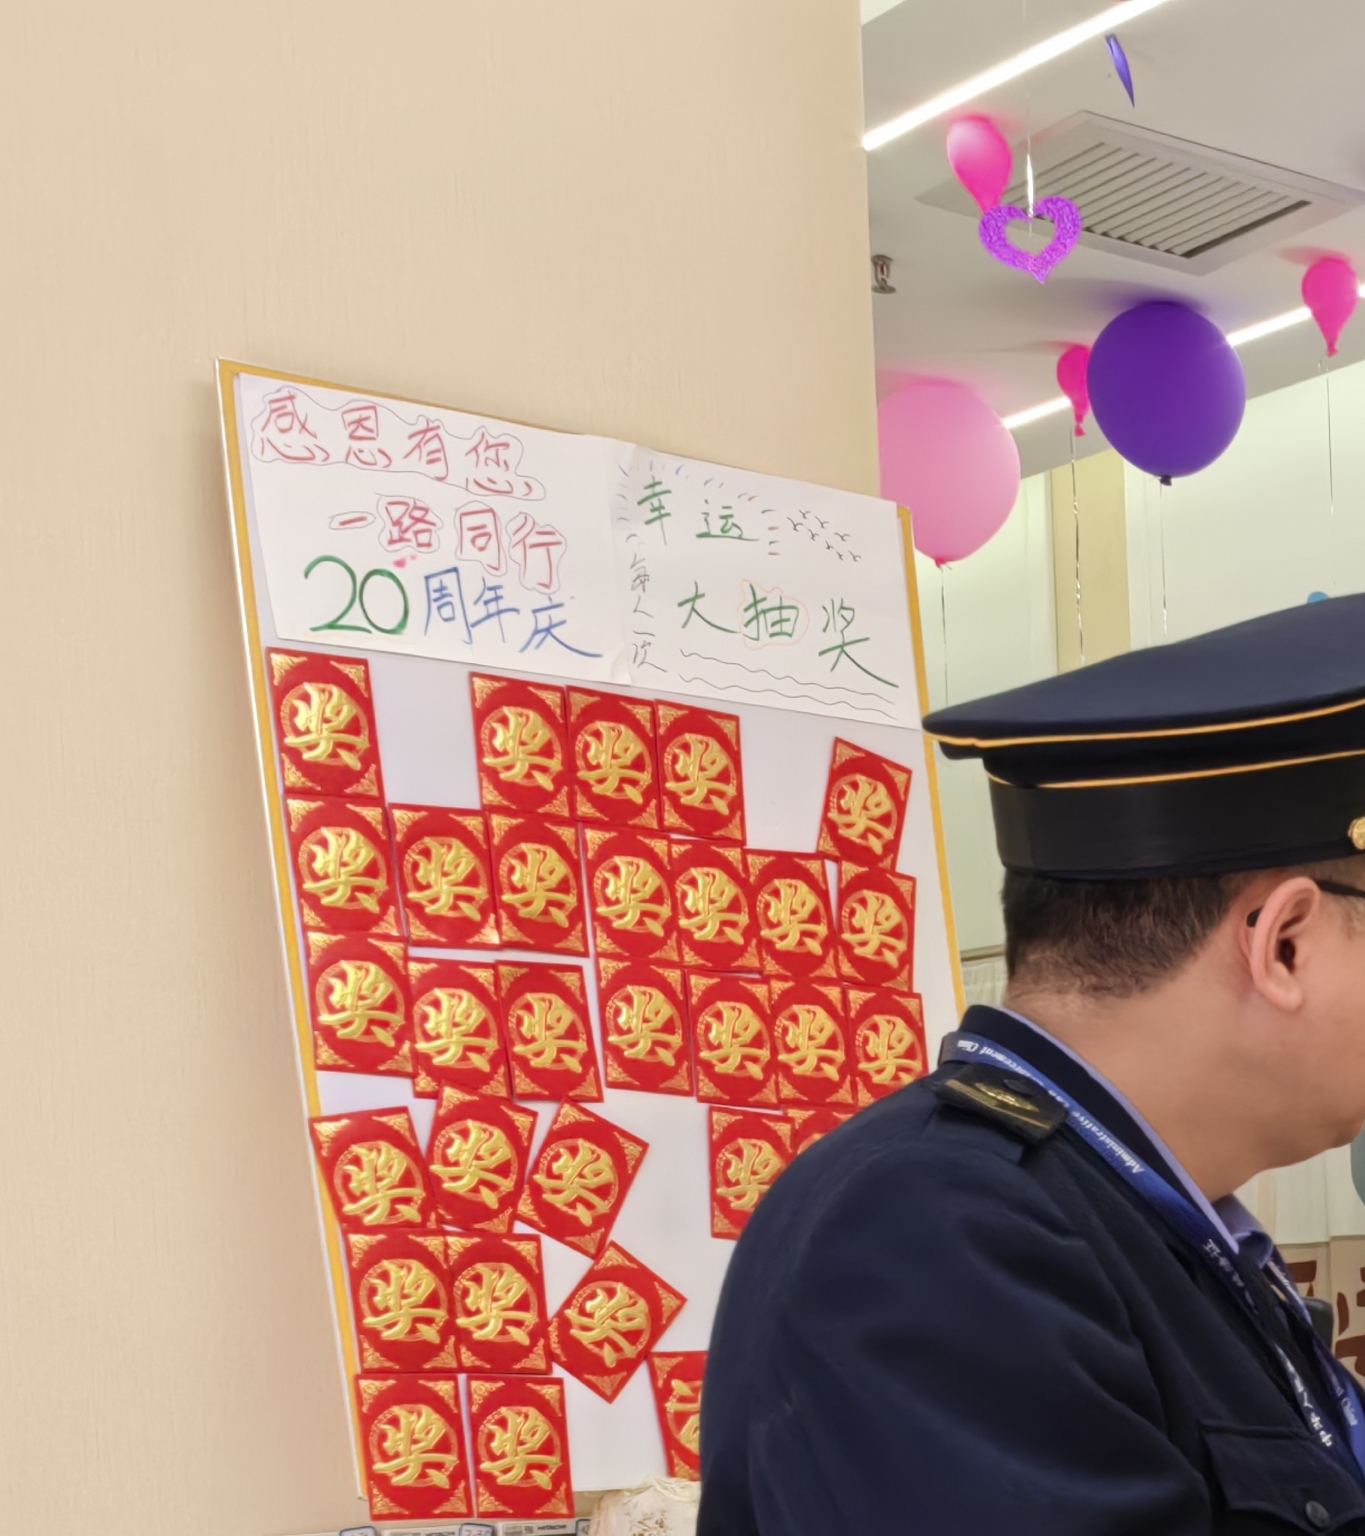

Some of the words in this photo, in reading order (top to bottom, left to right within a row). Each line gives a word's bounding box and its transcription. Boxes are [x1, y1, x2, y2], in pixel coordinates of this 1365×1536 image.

[258, 391, 535, 498] 感恩有您
[336, 500, 564, 590] 一路同行
[636, 478, 758, 546] 幸运
[677, 581, 900, 690] 大抽奖
[284, 681, 369, 769] 奖
[483, 704, 562, 791] 奖
[577, 720, 652, 803] 奖
[665, 732, 737, 815] 奖
[831, 773, 898, 854] 奖
[303, 825, 389, 914] 奖
[406, 836, 489, 918] 奖
[501, 843, 577, 927] 奖
[597, 856, 672, 937] 奖
[675, 866, 749, 944] 奖
[757, 877, 830, 955] 奖
[840, 889, 908, 968] 奖
[318, 958, 405, 1044] 奖
[415, 986, 499, 1071] 奖
[508, 991, 588, 1074] 奖
[606, 984, 682, 1065] 奖
[700, 1000, 770, 1080] 奖
[775, 1003, 844, 1081] 奖
[342, 1142, 426, 1225] 奖
[431, 1118, 515, 1208] 奖
[533, 1136, 619, 1227] 奖
[362, 1259, 449, 1345] 奖
[456, 1262, 537, 1346] 奖
[565, 1283, 651, 1368] 奖
[372, 1405, 459, 1488] 奖
[480, 1407, 561, 1489] 奖
